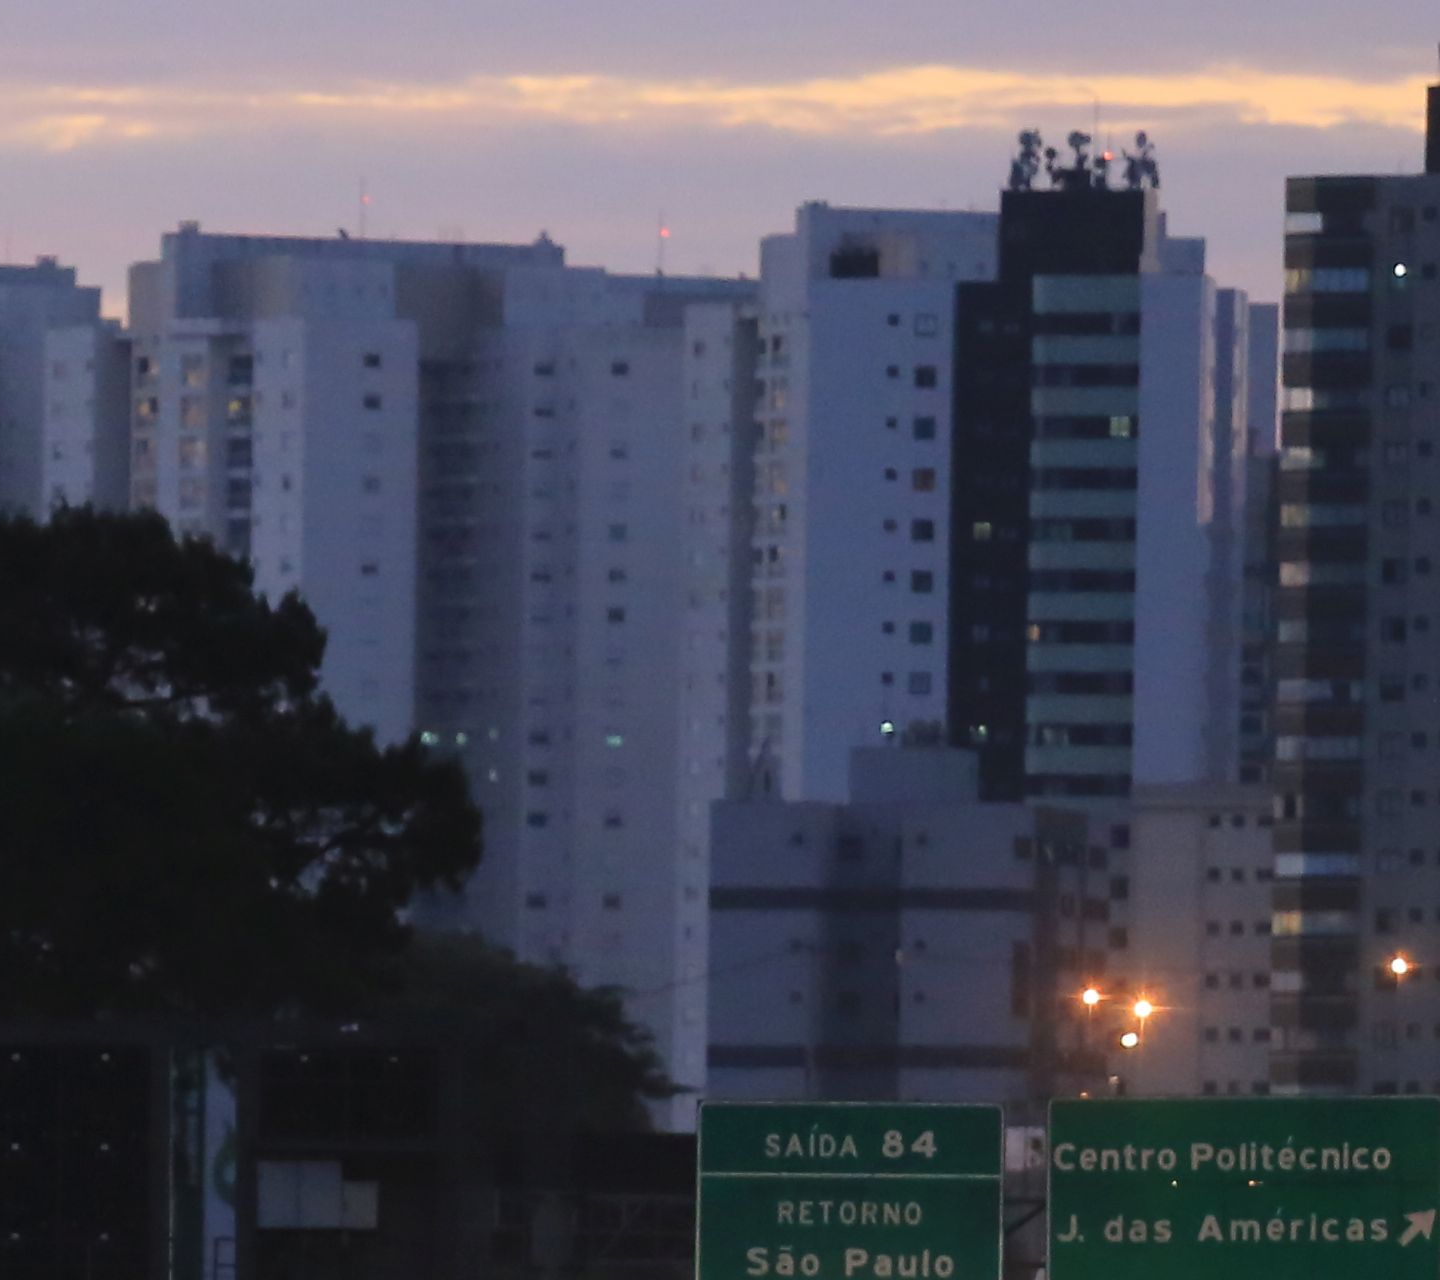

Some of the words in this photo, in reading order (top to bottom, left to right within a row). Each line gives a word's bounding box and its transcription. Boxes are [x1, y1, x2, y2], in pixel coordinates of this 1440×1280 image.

[764, 1124, 858, 1159] SAÍDA
[881, 1130, 938, 1159] 84
[1053, 1142, 1177, 1171] Centro
[1190, 1135, 1393, 1171] Politécnico
[776, 1200, 923, 1226] RETORNO
[1056, 1213, 1084, 1243] J.
[1103, 1213, 1174, 1243] das
[1196, 1206, 1389, 1243] Américas
[745, 1246, 821, 1277] São
[844, 1247, 955, 1278] Paulo
